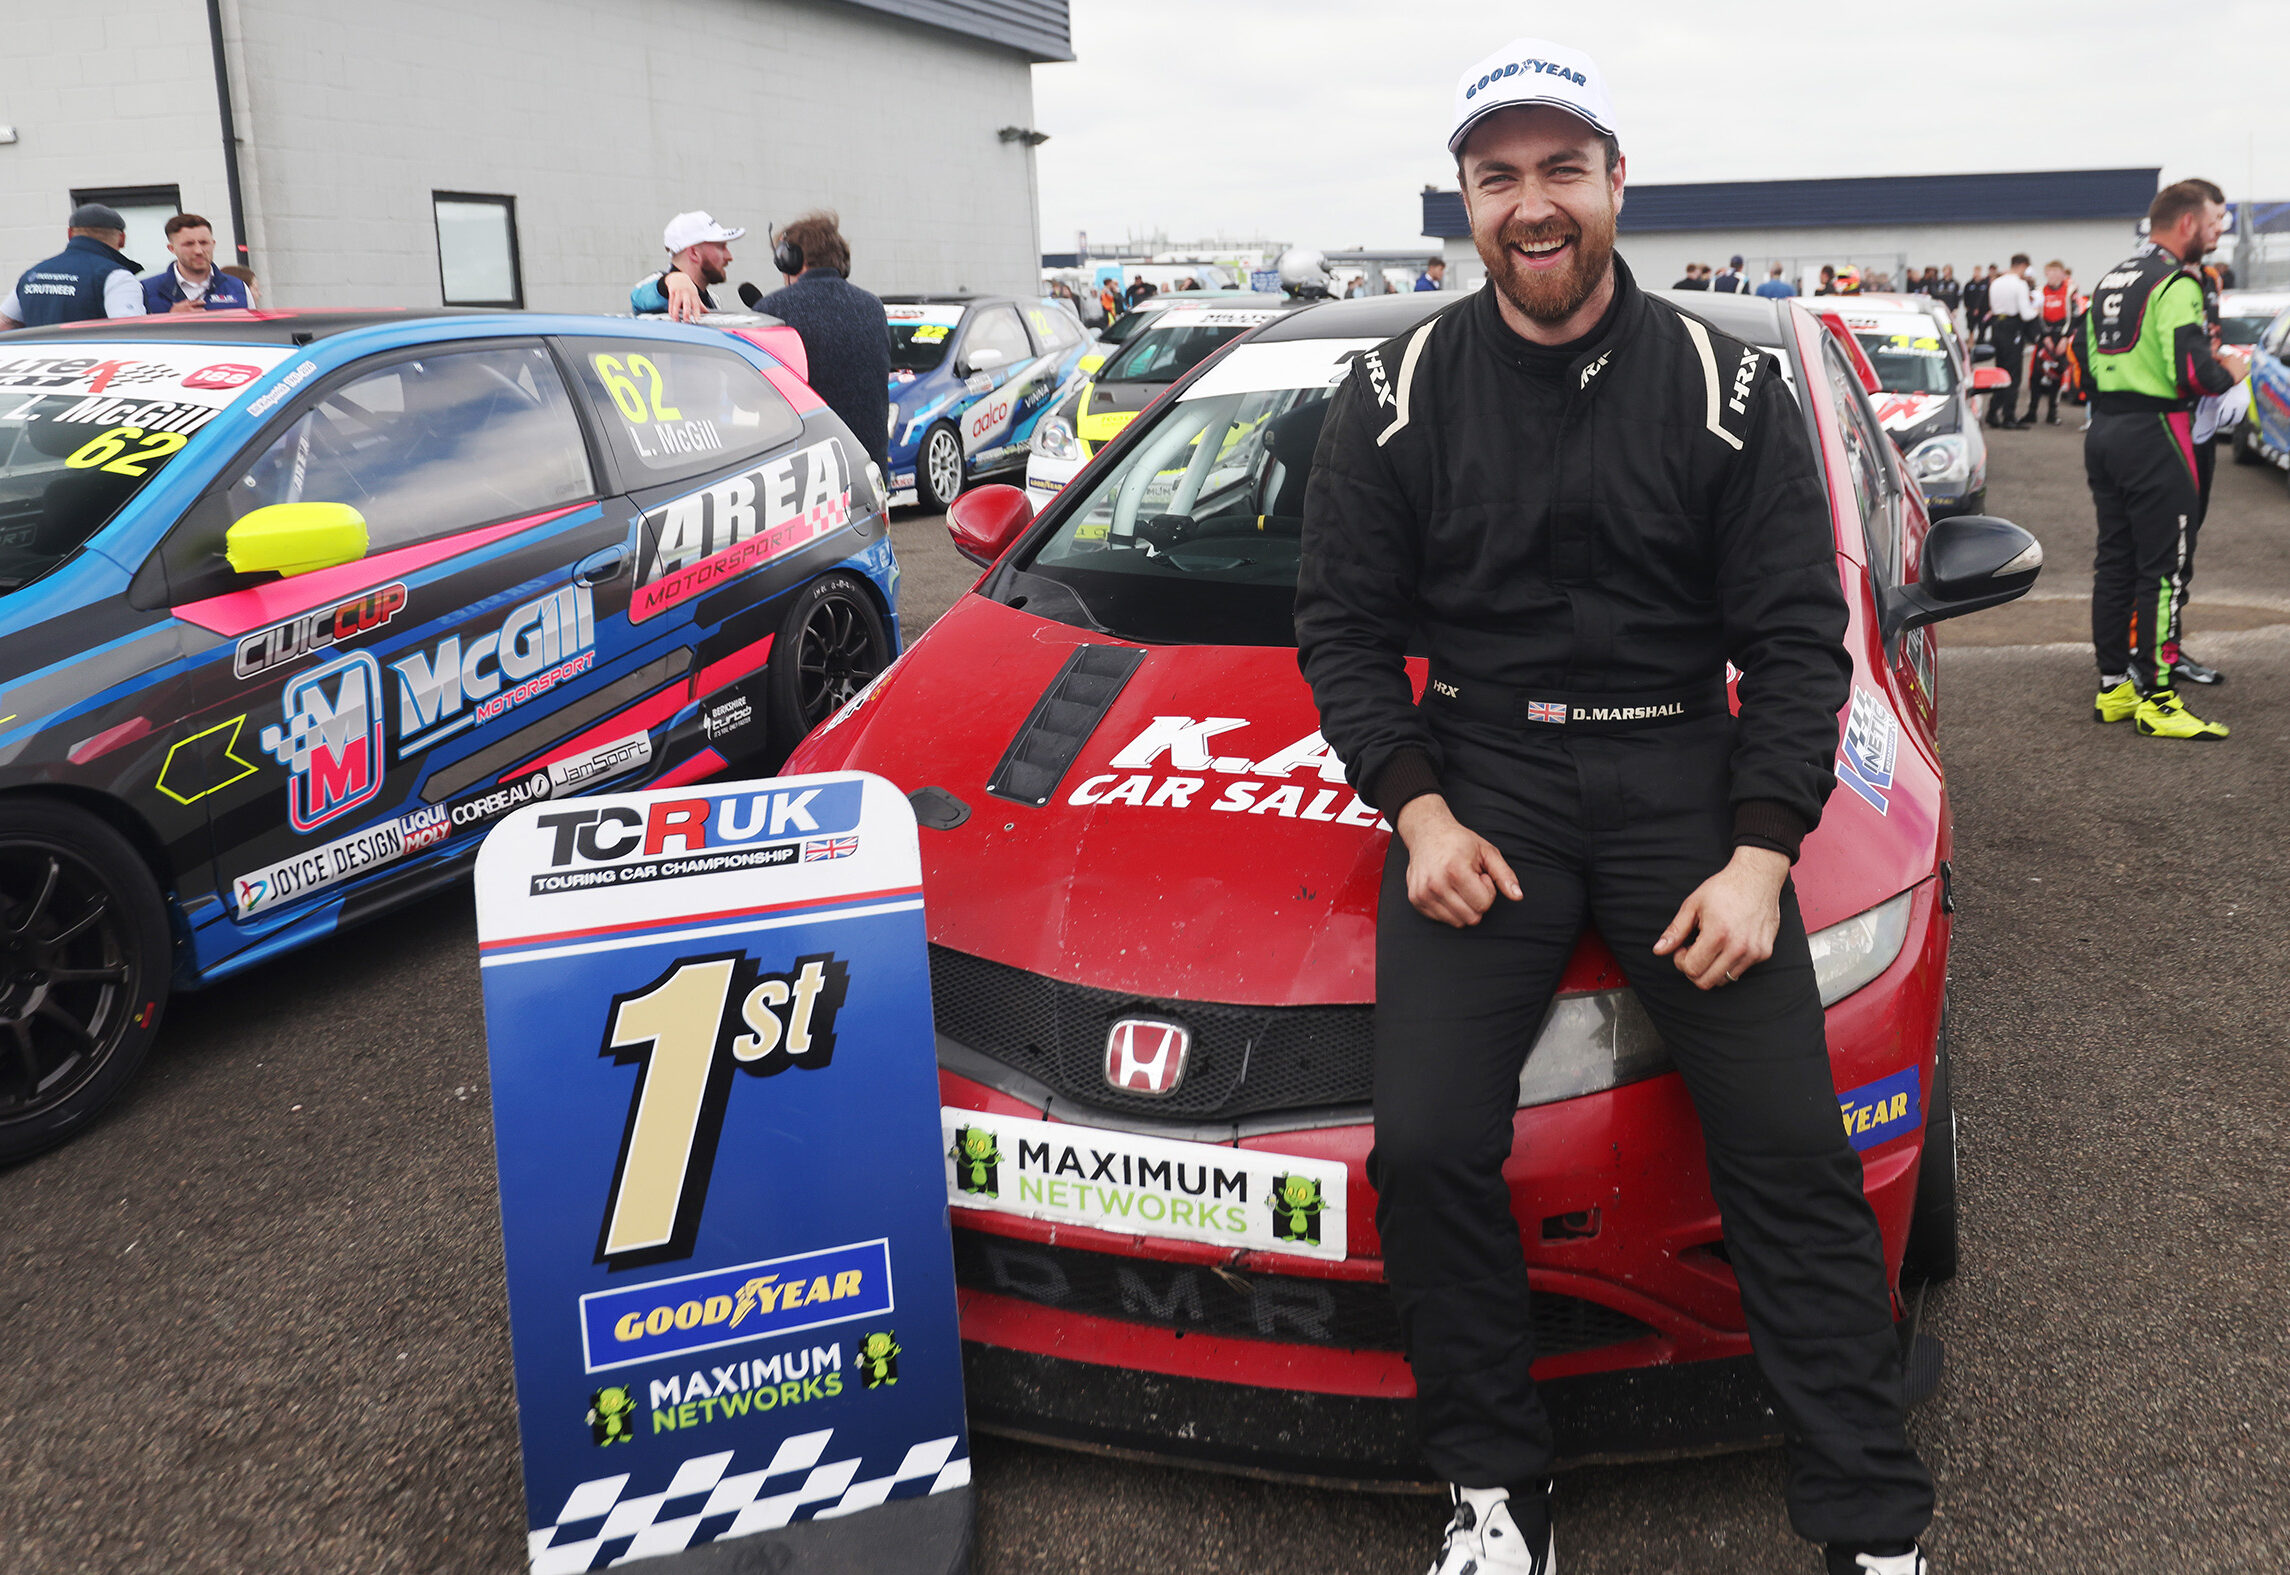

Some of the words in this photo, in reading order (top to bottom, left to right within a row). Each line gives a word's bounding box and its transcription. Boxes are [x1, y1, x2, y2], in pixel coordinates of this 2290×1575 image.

[24, 284, 76, 297] SCRUTINEER
[198, 368, 251, 385] 188
[596, 354, 683, 424] 62
[1364, 351, 1397, 408] HRX
[1728, 347, 1760, 415] HRX
[2, 394, 48, 421] L.
[53, 396, 221, 436] McGill
[629, 426, 657, 458] L.
[662, 419, 722, 455] McGill
[973, 401, 1008, 438] aalco
[65, 427, 188, 477] 62
[642, 440, 848, 582] AREA
[645, 524, 796, 609] MOTORSPORT
[393, 584, 596, 737] McGill
[475, 651, 595, 724] MOTORSPORT
[712, 696, 747, 718] BERKSHIRE
[1433, 679, 1459, 698] HRX
[1572, 702, 1684, 721] D.MARSHALL
[452, 784, 532, 825] CORBEAU
[1067, 774, 1205, 808] CAR
[401, 802, 447, 836] LIQUI
[403, 823, 451, 854] MOLY
[269, 856, 329, 901] JOYCE
[336, 826, 401, 874] DESIGN
[534, 869, 616, 892] TOURING
[620, 864, 657, 882] CAR
[660, 848, 793, 876] CHAMPIONSHIP
[604, 959, 826, 1256] 1st
[1018, 1139, 1248, 1203] MAXIMUM
[1019, 1175, 1248, 1233] NETWORKS
[650, 1342, 841, 1410] MAXIMUM
[653, 1372, 844, 1434] NETWORKS
